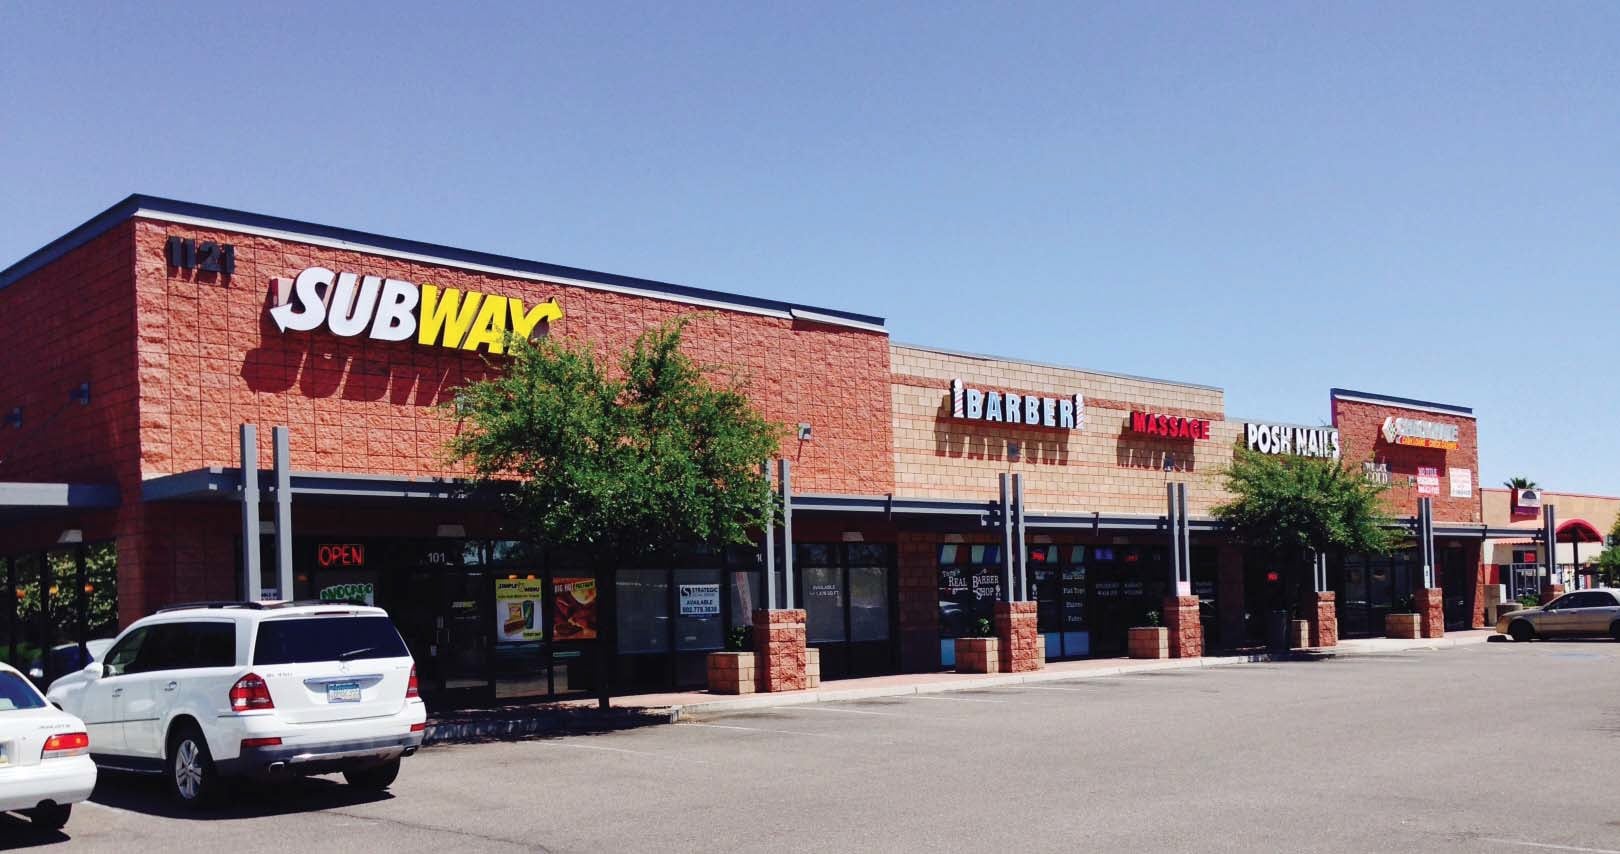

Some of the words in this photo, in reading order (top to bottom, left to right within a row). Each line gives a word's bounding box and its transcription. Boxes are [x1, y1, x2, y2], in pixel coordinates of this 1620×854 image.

[168, 236, 235, 274] 1121
[270, 266, 564, 356] SUBWAY
[964, 388, 1074, 429] BARBER
[1131, 411, 1210, 440] MASSAGE
[1245, 423, 1292, 456] POSH
[1295, 427, 1340, 459] NAILS
[319, 544, 364, 567] OPEN
[428, 552, 445, 564] 101
[320, 583, 373, 600] AVOCADO
